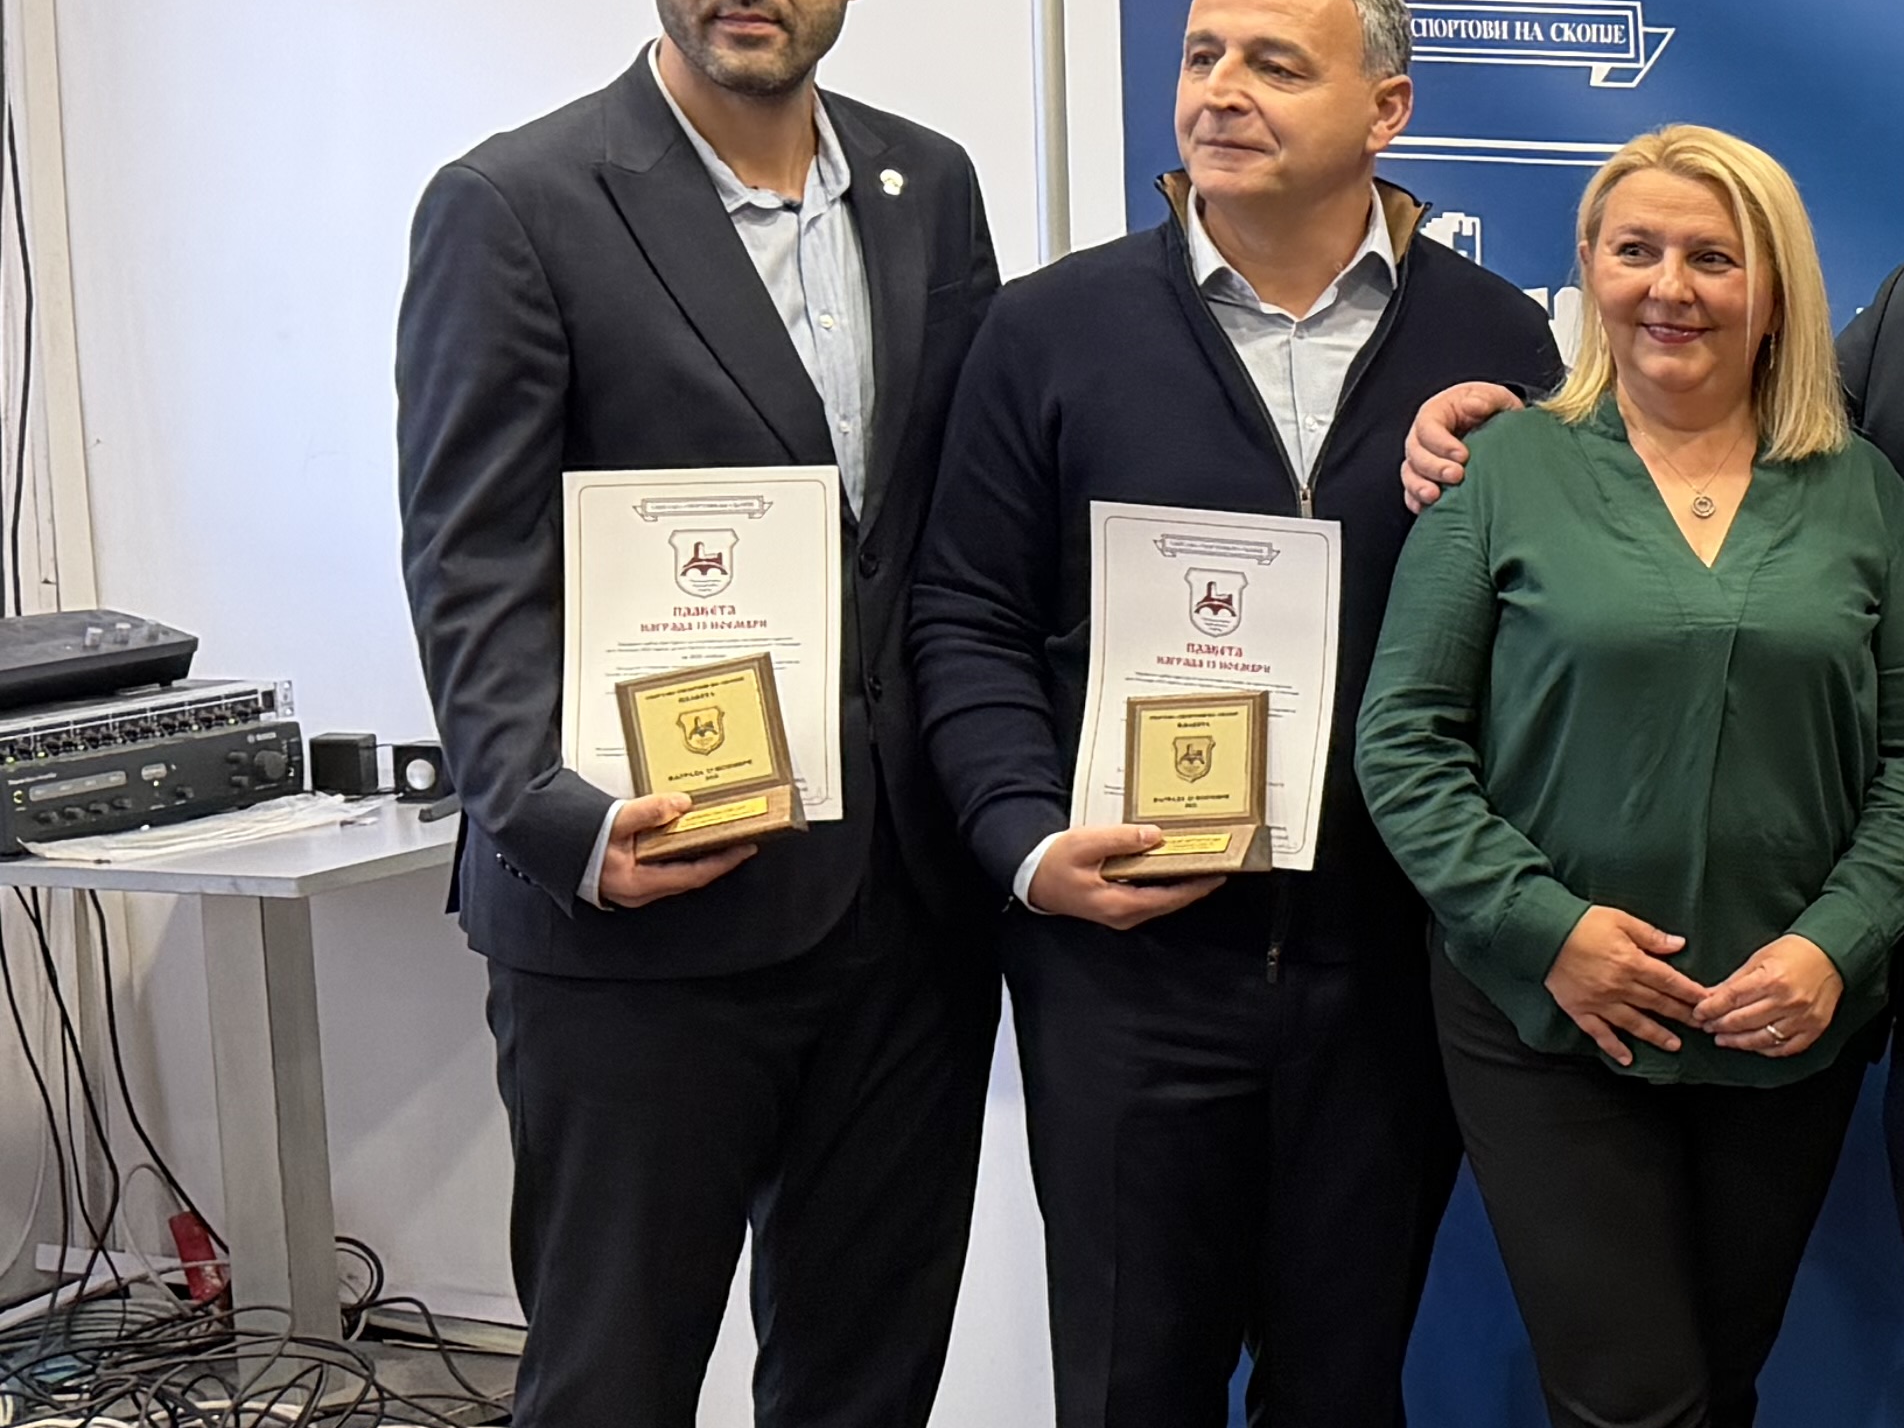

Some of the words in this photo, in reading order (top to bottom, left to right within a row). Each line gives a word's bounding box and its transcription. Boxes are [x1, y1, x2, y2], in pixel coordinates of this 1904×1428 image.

[1411, 18, 1509, 40] СПОРТОВИ
[1514, 21, 1544, 42] НА
[1551, 22, 1626, 45] СКОПЈЕ
